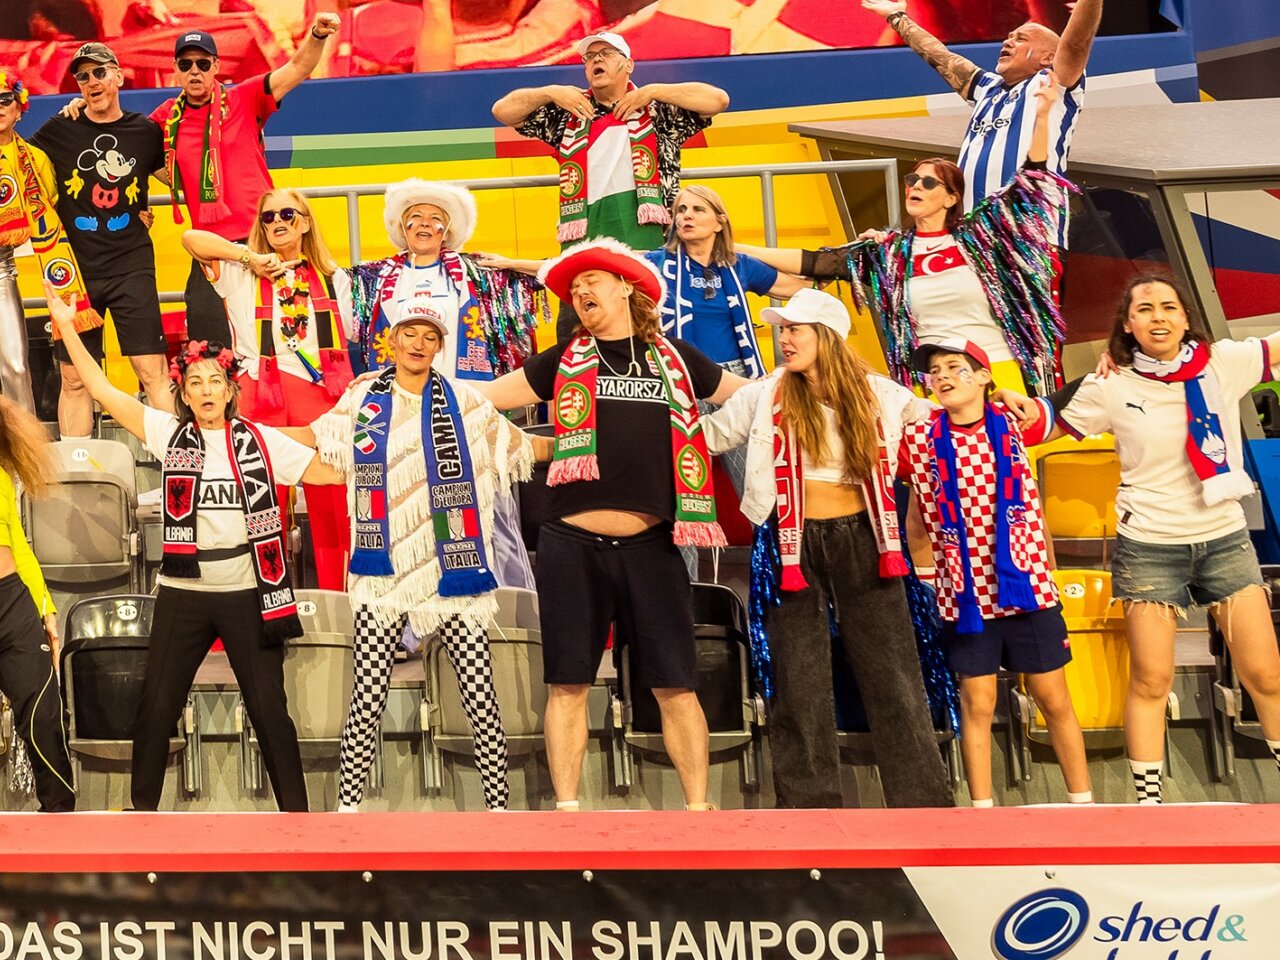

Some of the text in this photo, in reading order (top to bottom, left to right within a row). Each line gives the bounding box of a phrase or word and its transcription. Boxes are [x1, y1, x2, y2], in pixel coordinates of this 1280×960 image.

[407, 307, 443, 320] VENEZIA
[431, 482, 472, 497] CAMPIONI
[443, 552, 482, 569] ITALIA
[100, 921, 175, 960] IST
[191, 921, 344, 960] NICHT
[362, 921, 470, 960] NUR
[489, 921, 570, 960] EIN
[592, 920, 885, 960] SHAMPOO!
